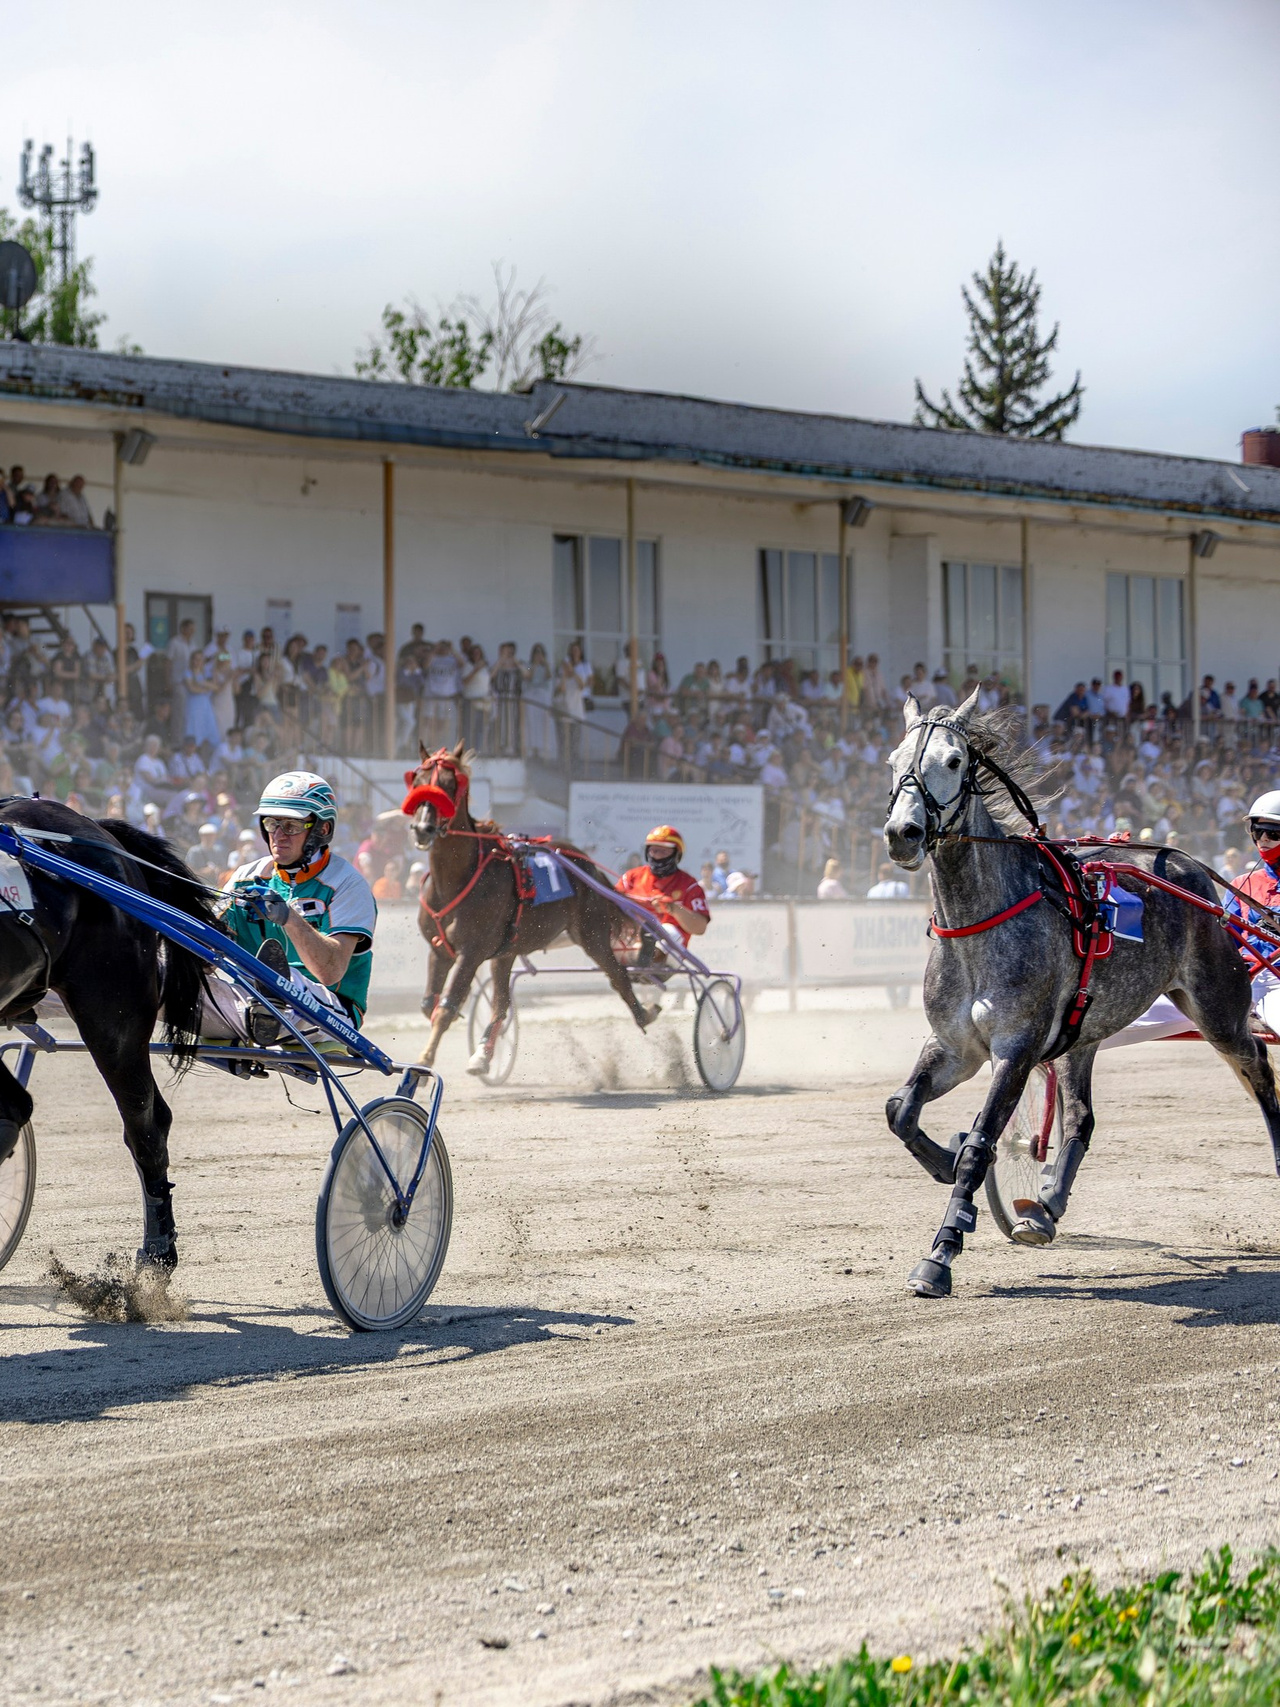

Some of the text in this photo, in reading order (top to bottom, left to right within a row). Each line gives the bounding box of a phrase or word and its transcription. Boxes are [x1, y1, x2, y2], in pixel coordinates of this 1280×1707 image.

[534, 851, 562, 893] 7
[276, 974, 322, 1013] CUSTOM
[326, 1014, 360, 1044] MULTIFLEX
